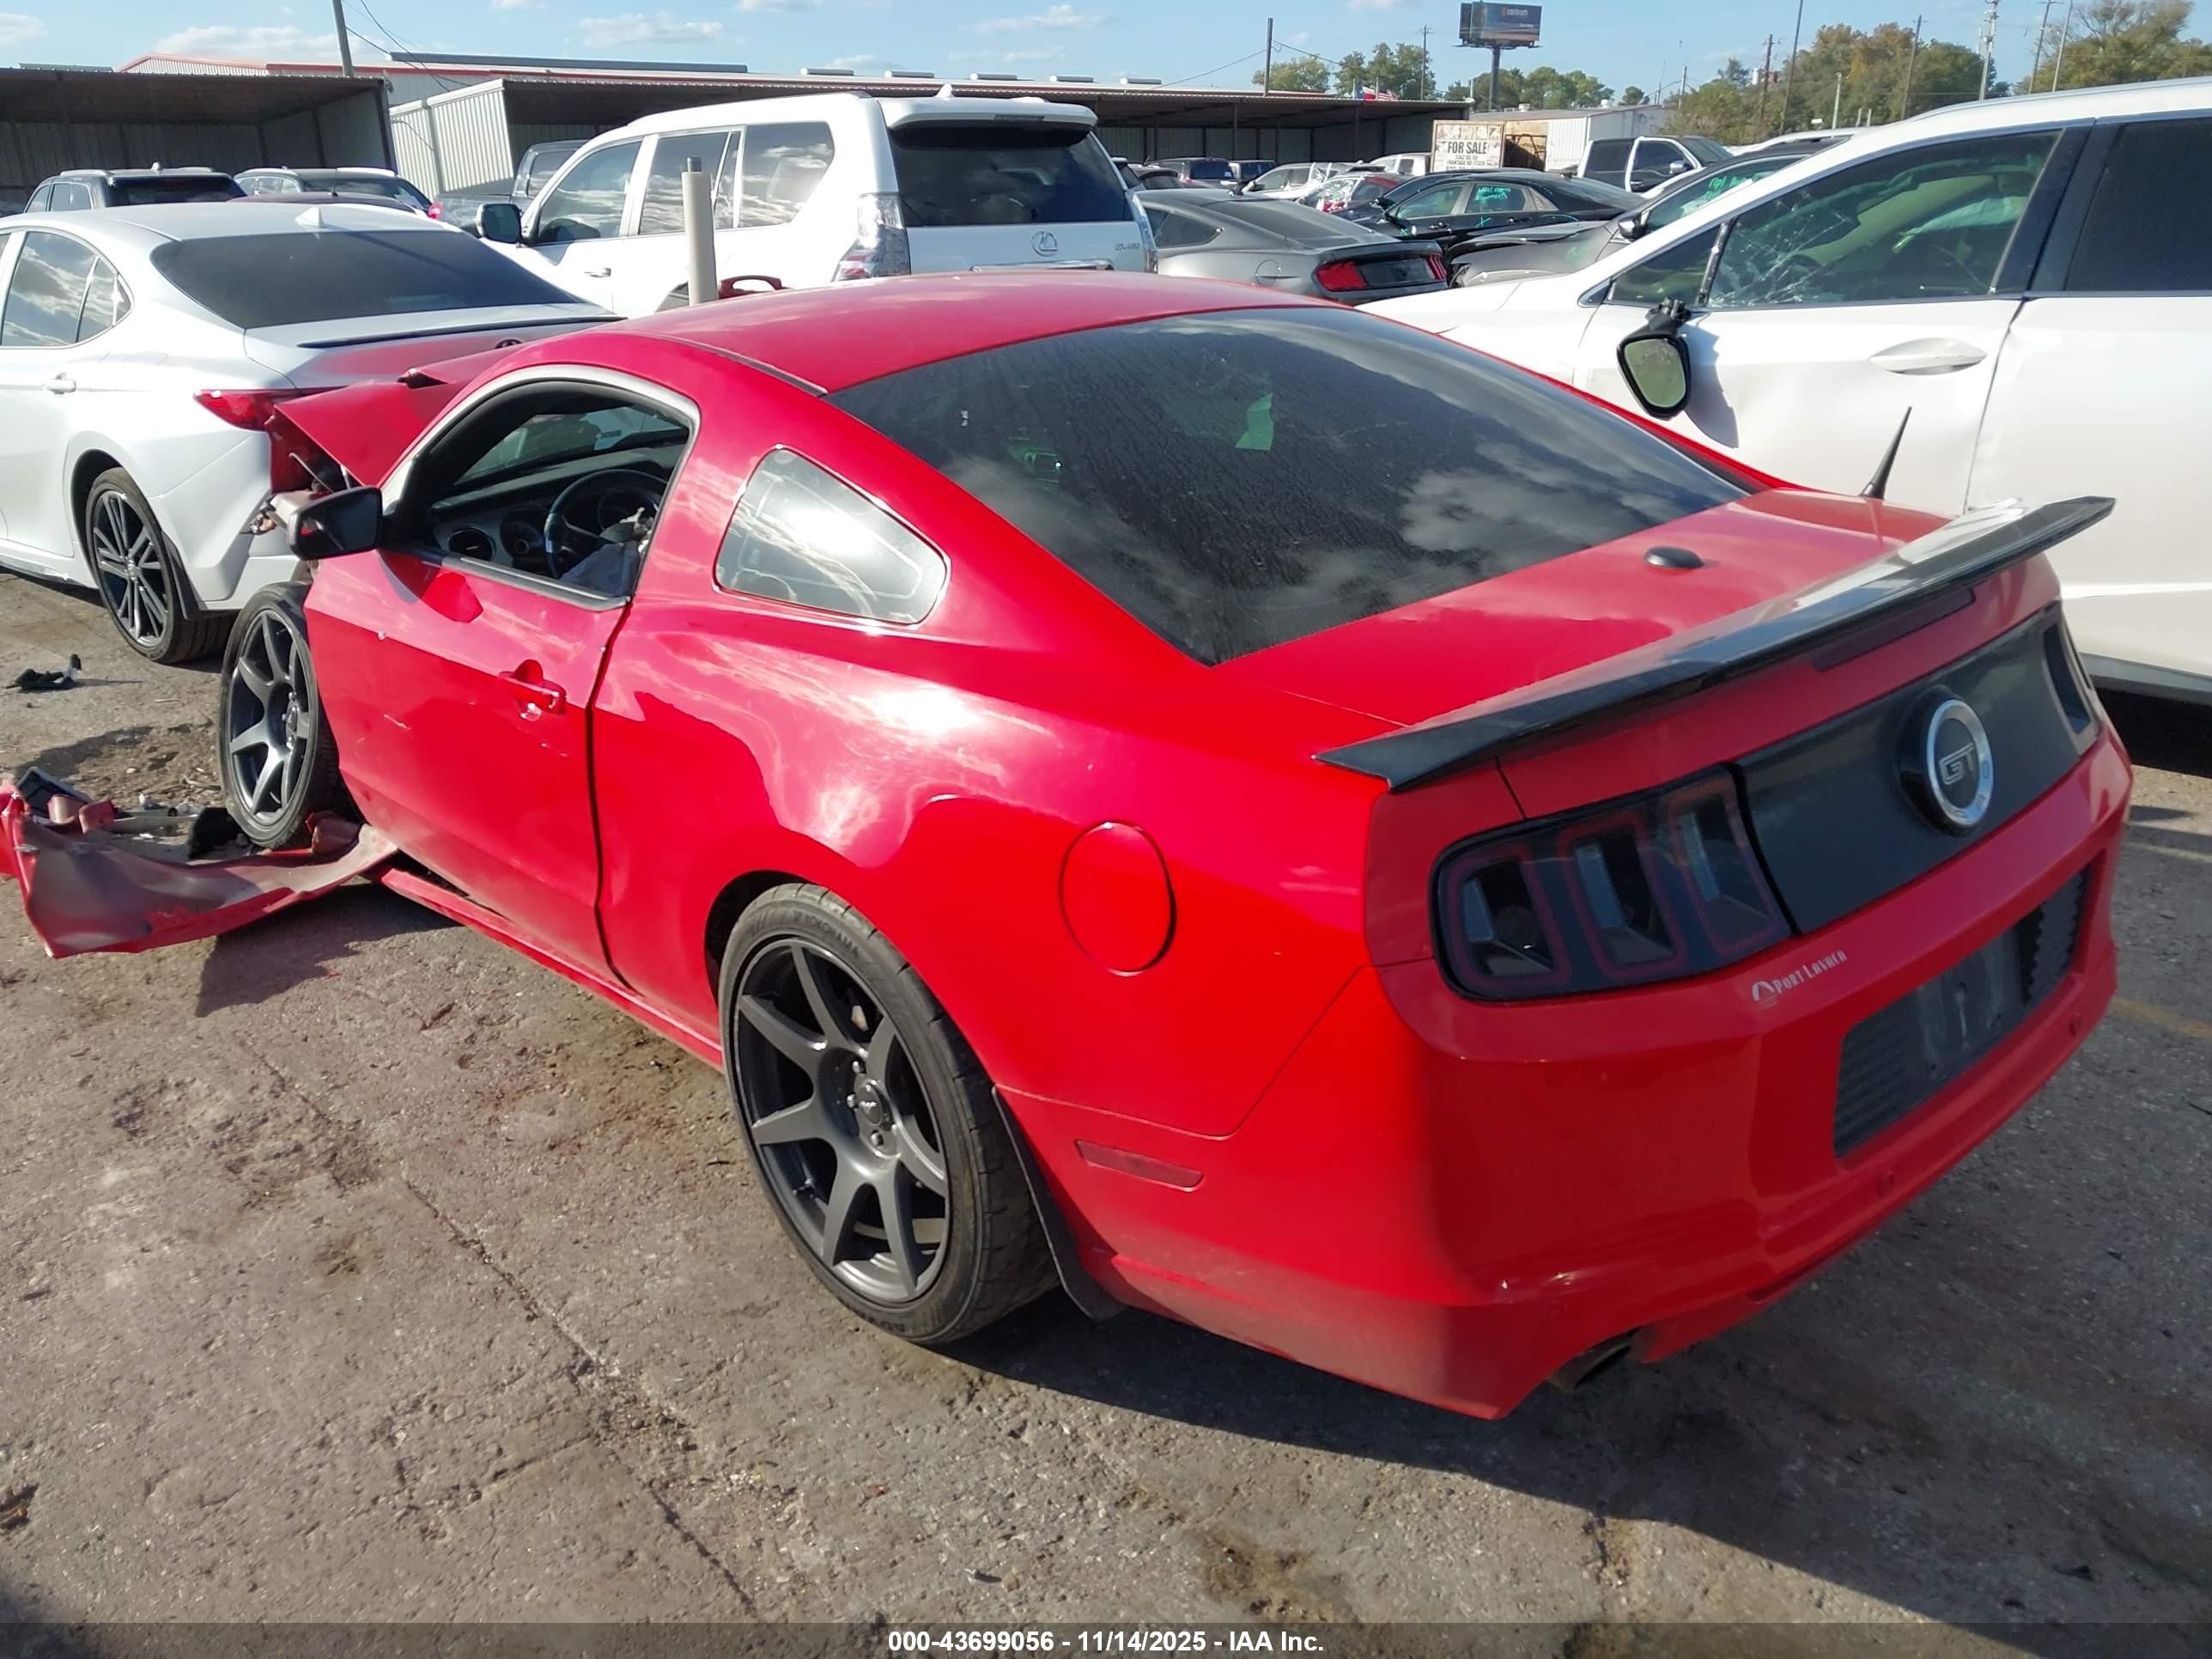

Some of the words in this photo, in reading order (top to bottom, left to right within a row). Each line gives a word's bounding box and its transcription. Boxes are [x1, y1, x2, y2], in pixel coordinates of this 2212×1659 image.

[1448, 141, 1464, 154] FOR
[1466, 141, 1487, 155] SALE
[1939, 742, 1975, 786] GT
